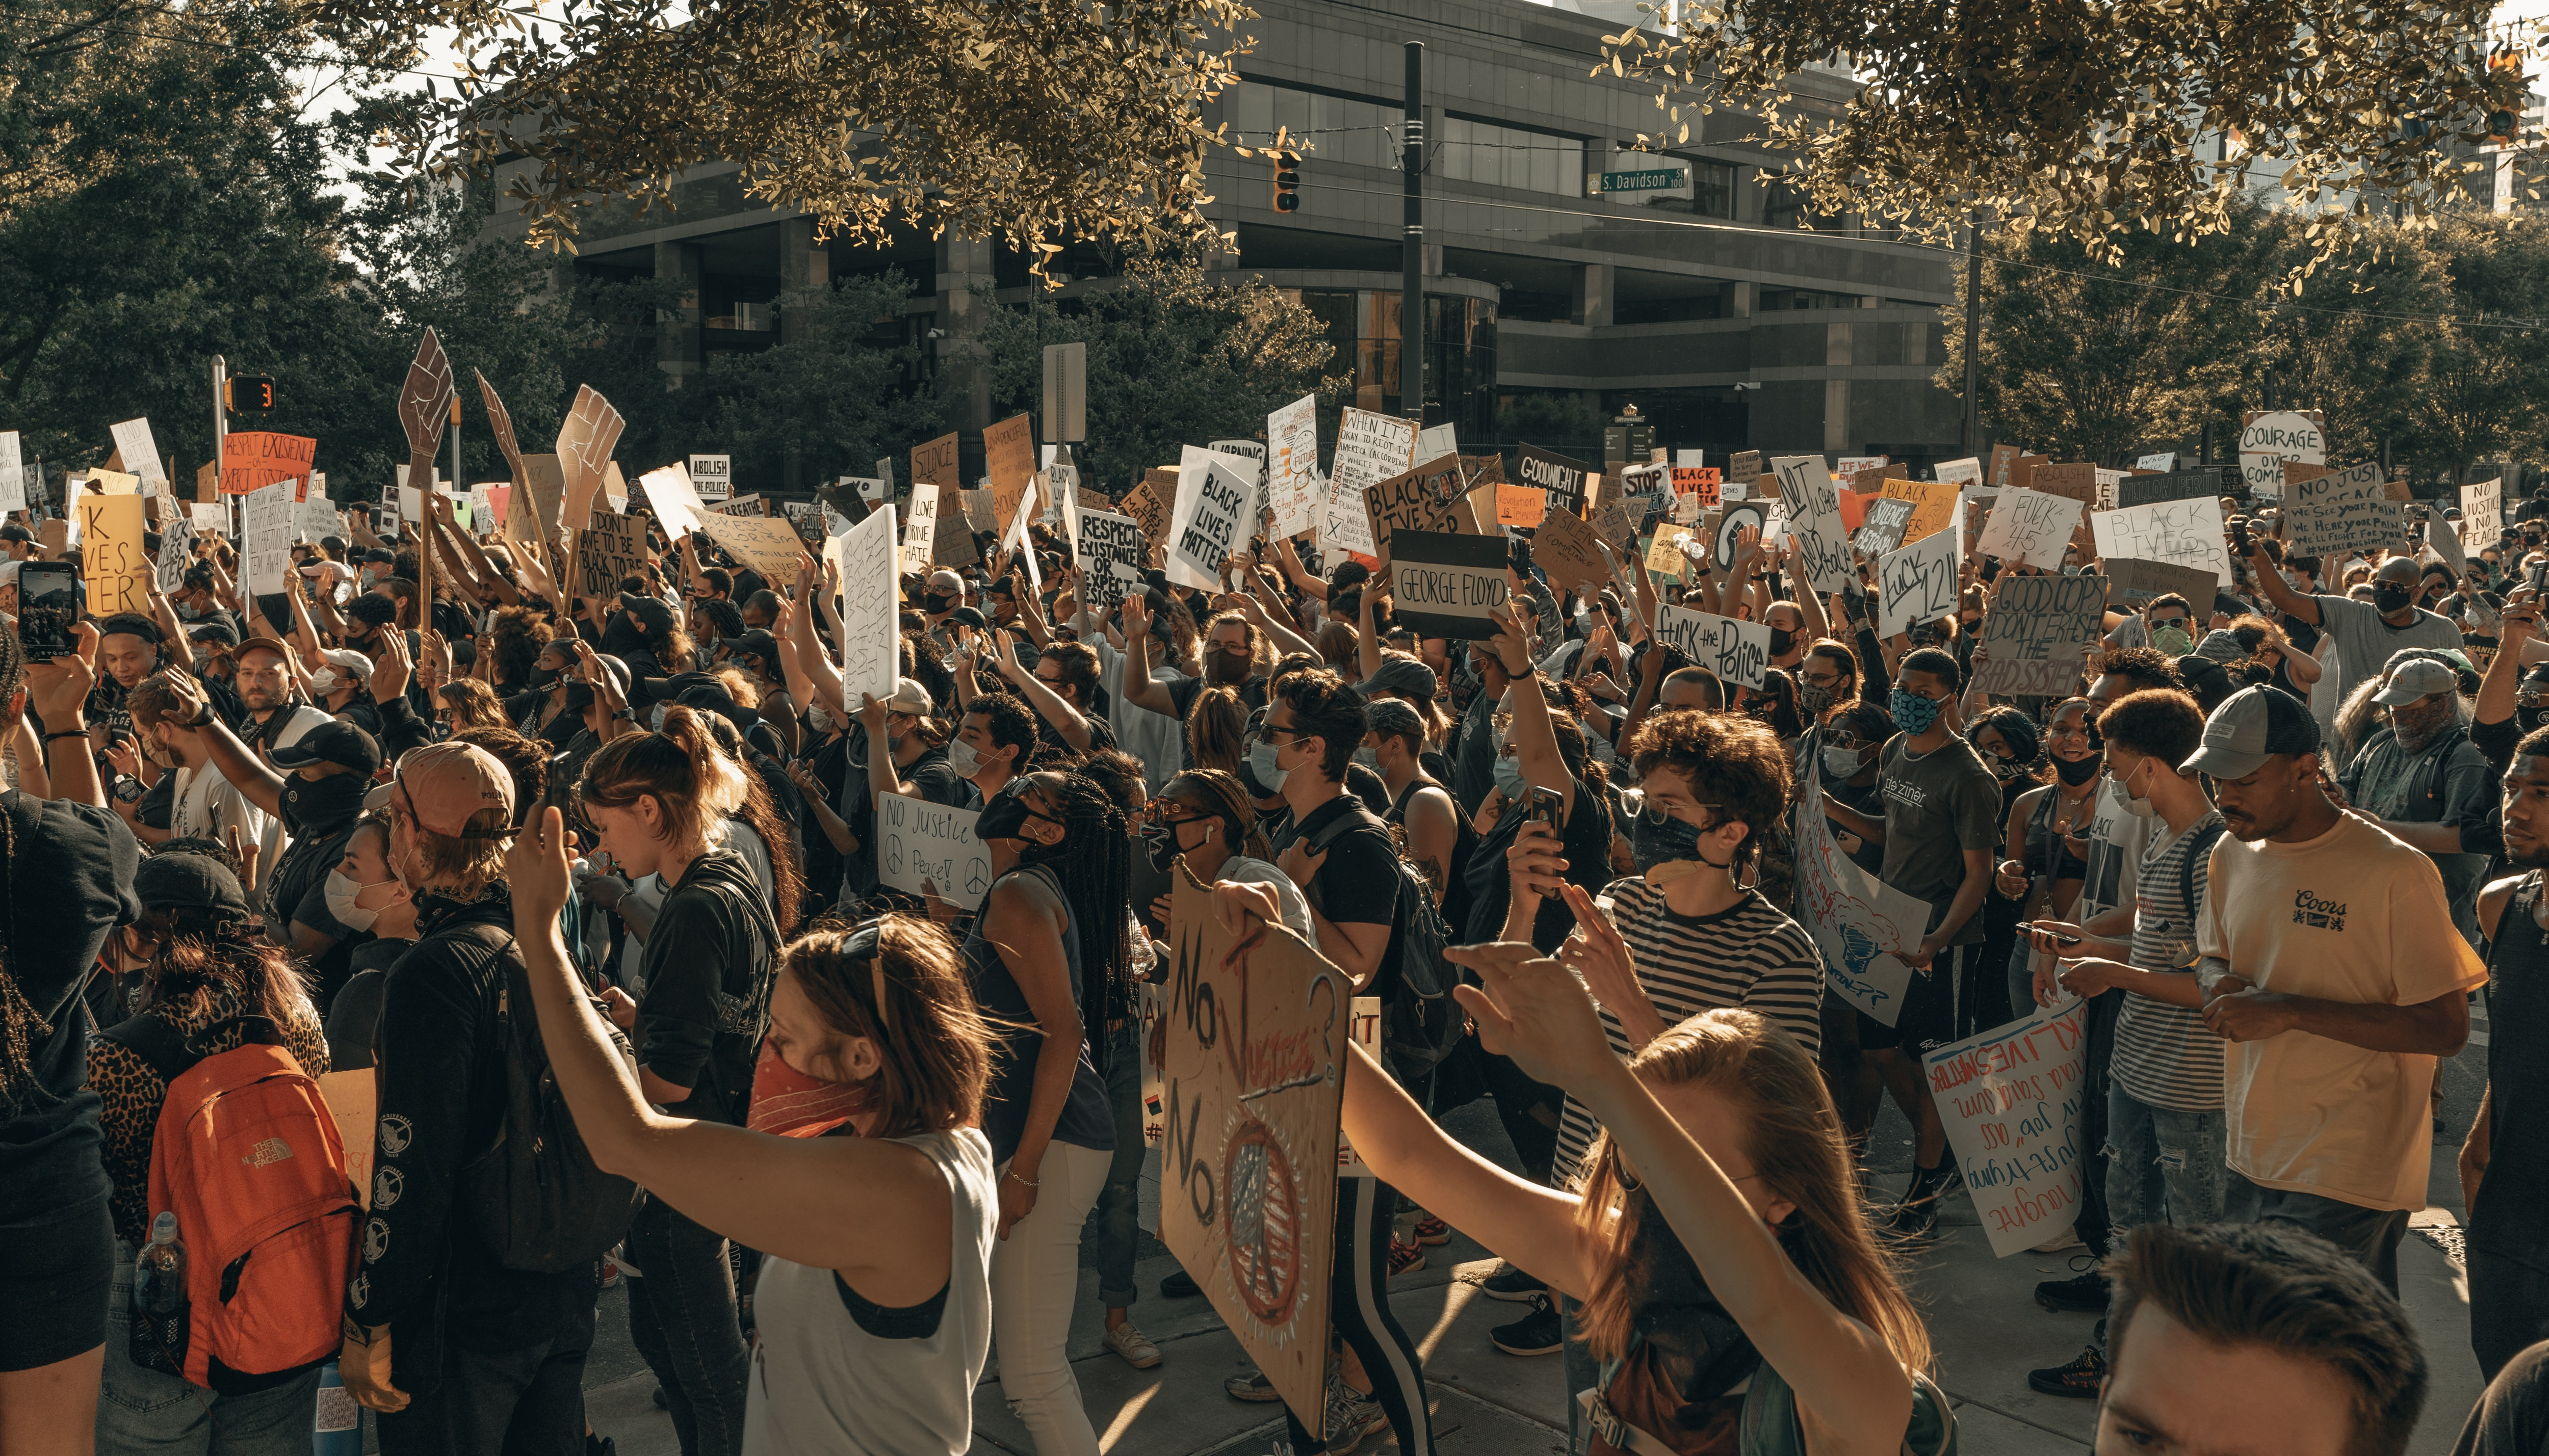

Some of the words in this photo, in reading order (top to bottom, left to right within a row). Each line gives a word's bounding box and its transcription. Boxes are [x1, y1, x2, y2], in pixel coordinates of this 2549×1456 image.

[1604, 176, 1612, 190] S.
[1617, 173, 1665, 189] Davidson
[1676, 169, 1683, 178] St
[1671, 179, 1683, 188] 100
[262, 383, 272, 407] 3
[120, 421, 141, 442] END
[999, 422, 1028, 446] PEACEFUL
[1345, 413, 1378, 433] WHEN
[226, 434, 259, 456] RESPECT
[262, 434, 317, 464] EXISTENCE
[1339, 442, 1366, 456] AMERICA
[1341, 430, 1359, 442] OKAY
[1363, 434, 1370, 443] TO
[1373, 437, 1394, 452] RIOT
[1397, 446, 1410, 457] IN
[2244, 426, 2318, 450] COURAGE
[122, 442, 151, 464] WHITE
[1295, 449, 1316, 468] FUTURE
[1348, 457, 1373, 469] WHITE
[694, 461, 726, 474] ABOLISH
[1521, 456, 1581, 494] GOODNIGHT
[1673, 468, 1714, 481] BLACK
[1839, 461, 1855, 472] IF
[1858, 460, 1875, 470] WE
[1858, 468, 1890, 483] BLACK
[1960, 468, 1979, 478] people
[2035, 467, 2086, 482] ABOLISH
[155, 480, 169, 498] BLACK
[219, 468, 251, 492] EXPECT
[694, 481, 703, 492] THE
[705, 482, 726, 492] POLICE
[1625, 470, 1662, 496] STOP
[1673, 484, 1714, 494] LIVES
[1722, 487, 1738, 495] LIVES
[2121, 478, 2173, 503] YELLOW
[2177, 474, 2216, 497] PERIL
[2299, 479, 2329, 500] NO
[2474, 483, 2491, 498] NO
[269, 490, 285, 503] WHOLE
[628, 494, 651, 506] YOUR
[1139, 486, 1162, 515] BLACK
[1202, 473, 1243, 520] BLACK
[1368, 474, 1433, 518] BLACK
[1499, 495, 1535, 506] Revolution
[1886, 482, 1929, 501] BLACK
[2040, 486, 2088, 498] POLICE
[268, 500, 294, 528] ABUSIVE
[725, 498, 764, 516] BREATHE
[916, 500, 934, 518] LOVE
[1143, 504, 1163, 527] LIVES
[1276, 498, 1291, 514] Stop
[2012, 495, 2058, 531] FUCK
[2463, 493, 2501, 517] JUSTICE
[693, 510, 773, 535] ADDRESS
[1124, 497, 1158, 540] MATTER
[1195, 506, 1233, 546] LIVES
[1347, 515, 1365, 528] WHEN
[1376, 500, 1436, 546] LIVES
[1596, 510, 1625, 531] NEED
[2111, 503, 2209, 537] BLACK
[2476, 515, 2490, 530] NO
[261, 525, 291, 554] PREJUDICED
[710, 526, 796, 544] COLORISM
[803, 530, 820, 540] #BLM
[907, 524, 930, 542] DRIVE
[1082, 515, 1137, 547] RESPECT
[1879, 525, 1885, 535] IS
[2009, 525, 2041, 551] 45
[2463, 525, 2499, 546] PEACE
[602, 533, 615, 553] TO
[619, 536, 634, 555] BE
[905, 545, 928, 562] HATE
[1078, 538, 1137, 568] EXISTANCE
[1179, 526, 1227, 576] MATTER
[1546, 534, 1596, 568] COMPLIANCE
[2114, 528, 2199, 559] LIVES
[2305, 539, 2398, 555] #WEAREONENATION
[266, 552, 283, 574] AWAY
[580, 550, 610, 573] BLACK
[612, 556, 626, 576] TO
[864, 525, 877, 610] RACISM
[1094, 558, 1113, 576] OR
[1557, 550, 1570, 563] WITH
[2133, 561, 2151, 571] No
[842, 540, 854, 620] RACISM
[1400, 568, 1458, 605] GEORGE
[1463, 573, 1505, 607] FLOYD
[1918, 551, 1957, 622] 12!!
[2132, 575, 2148, 585] No
[1999, 576, 2053, 613] GOOD
[2053, 576, 2108, 613] COPS
[2130, 590, 2149, 598] BLM
[2043, 613, 2100, 645] ERASE
[1699, 628, 1719, 647] the
[1715, 620, 1764, 685] Police
[2015, 638, 2053, 660] THE
[868, 651, 878, 685] TO
[1972, 658, 2021, 693] BAD
[2017, 659, 2087, 697] SYSTEM
[539, 681, 559, 691] JUSTICE
[886, 799, 905, 828] NO
[913, 850, 953, 892] Peace!
[2295, 889, 2347, 916] Coors
[1173, 921, 1217, 1050] No
[252, 1138, 273, 1151] THE
[1980, 1123, 2010, 1151] ass
[241, 1147, 277, 1166] NORTH
[254, 1153, 280, 1170] FACE
[1165, 1077, 1215, 1227] No
